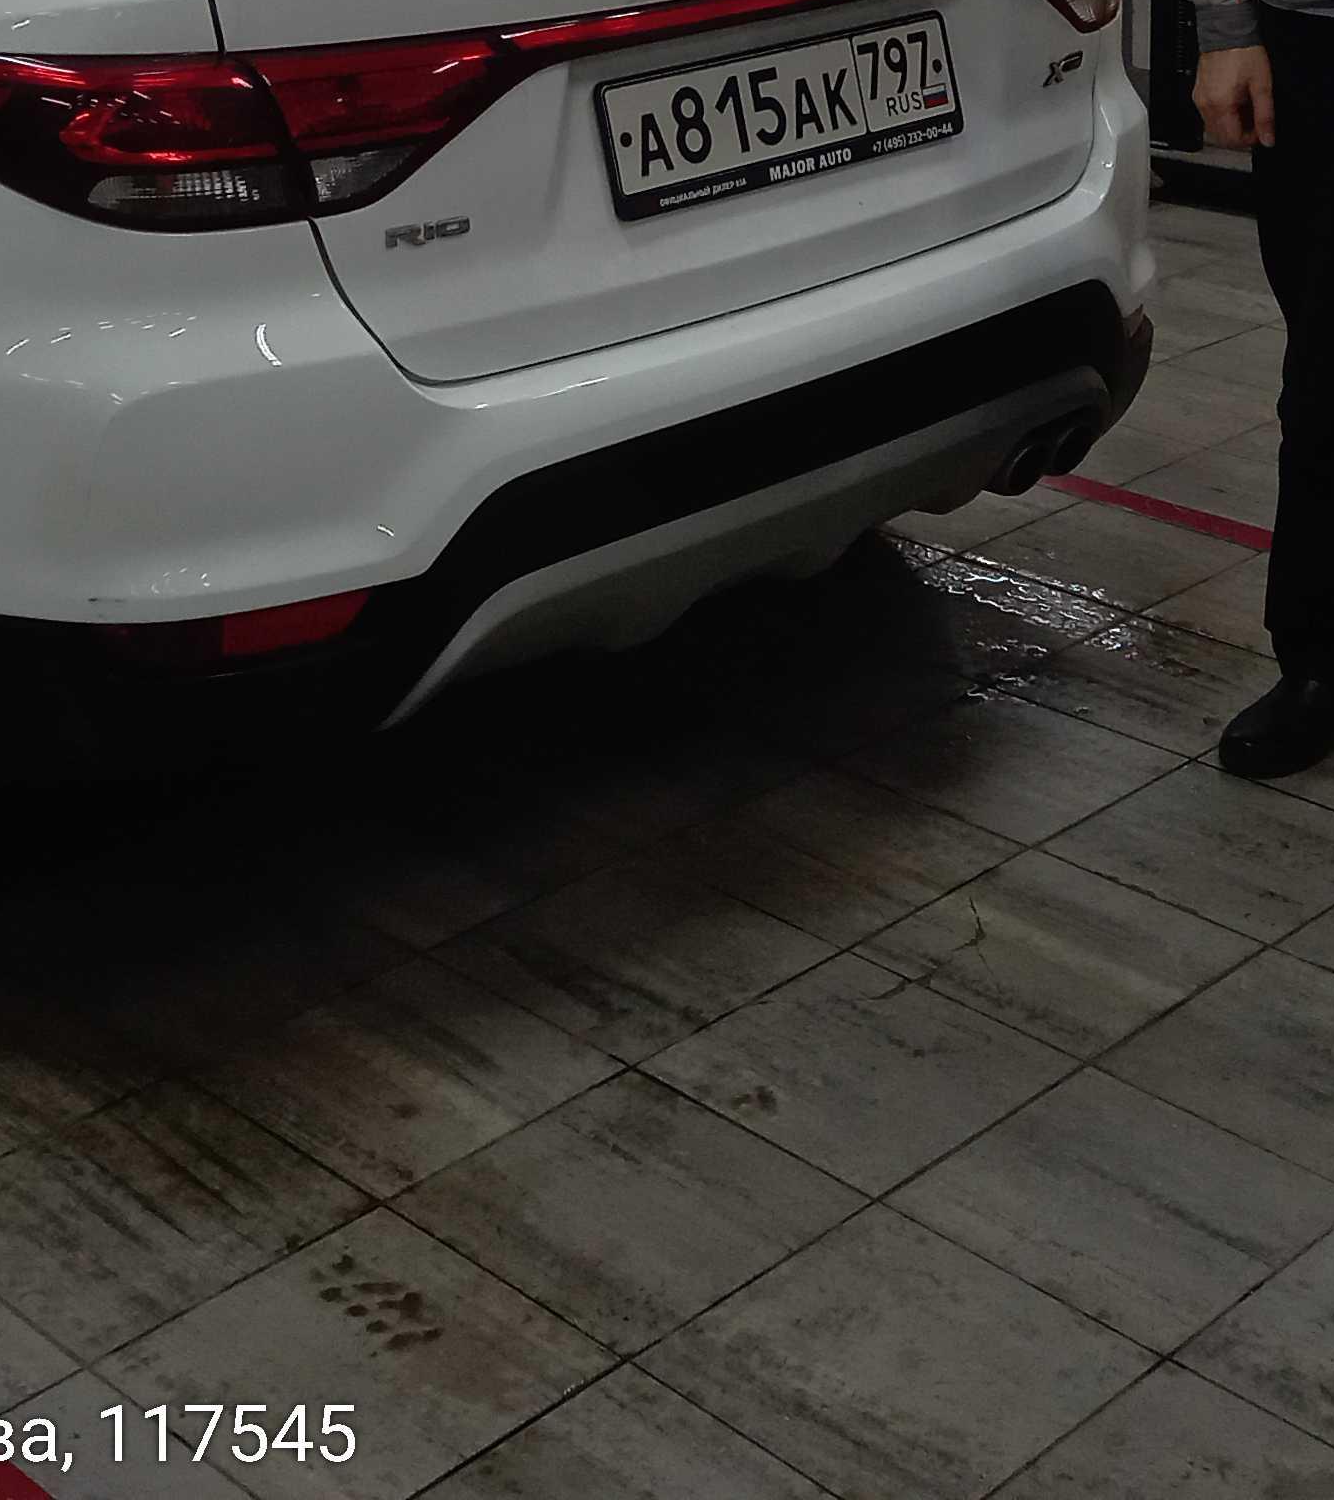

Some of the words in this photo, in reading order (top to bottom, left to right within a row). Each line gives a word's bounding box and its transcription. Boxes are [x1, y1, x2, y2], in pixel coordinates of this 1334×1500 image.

[857, 31, 930, 100] 797
[886, 92, 922, 117] RUS
[769, 157, 816, 182] MAJOR
[819, 148, 853, 169] AUTO
